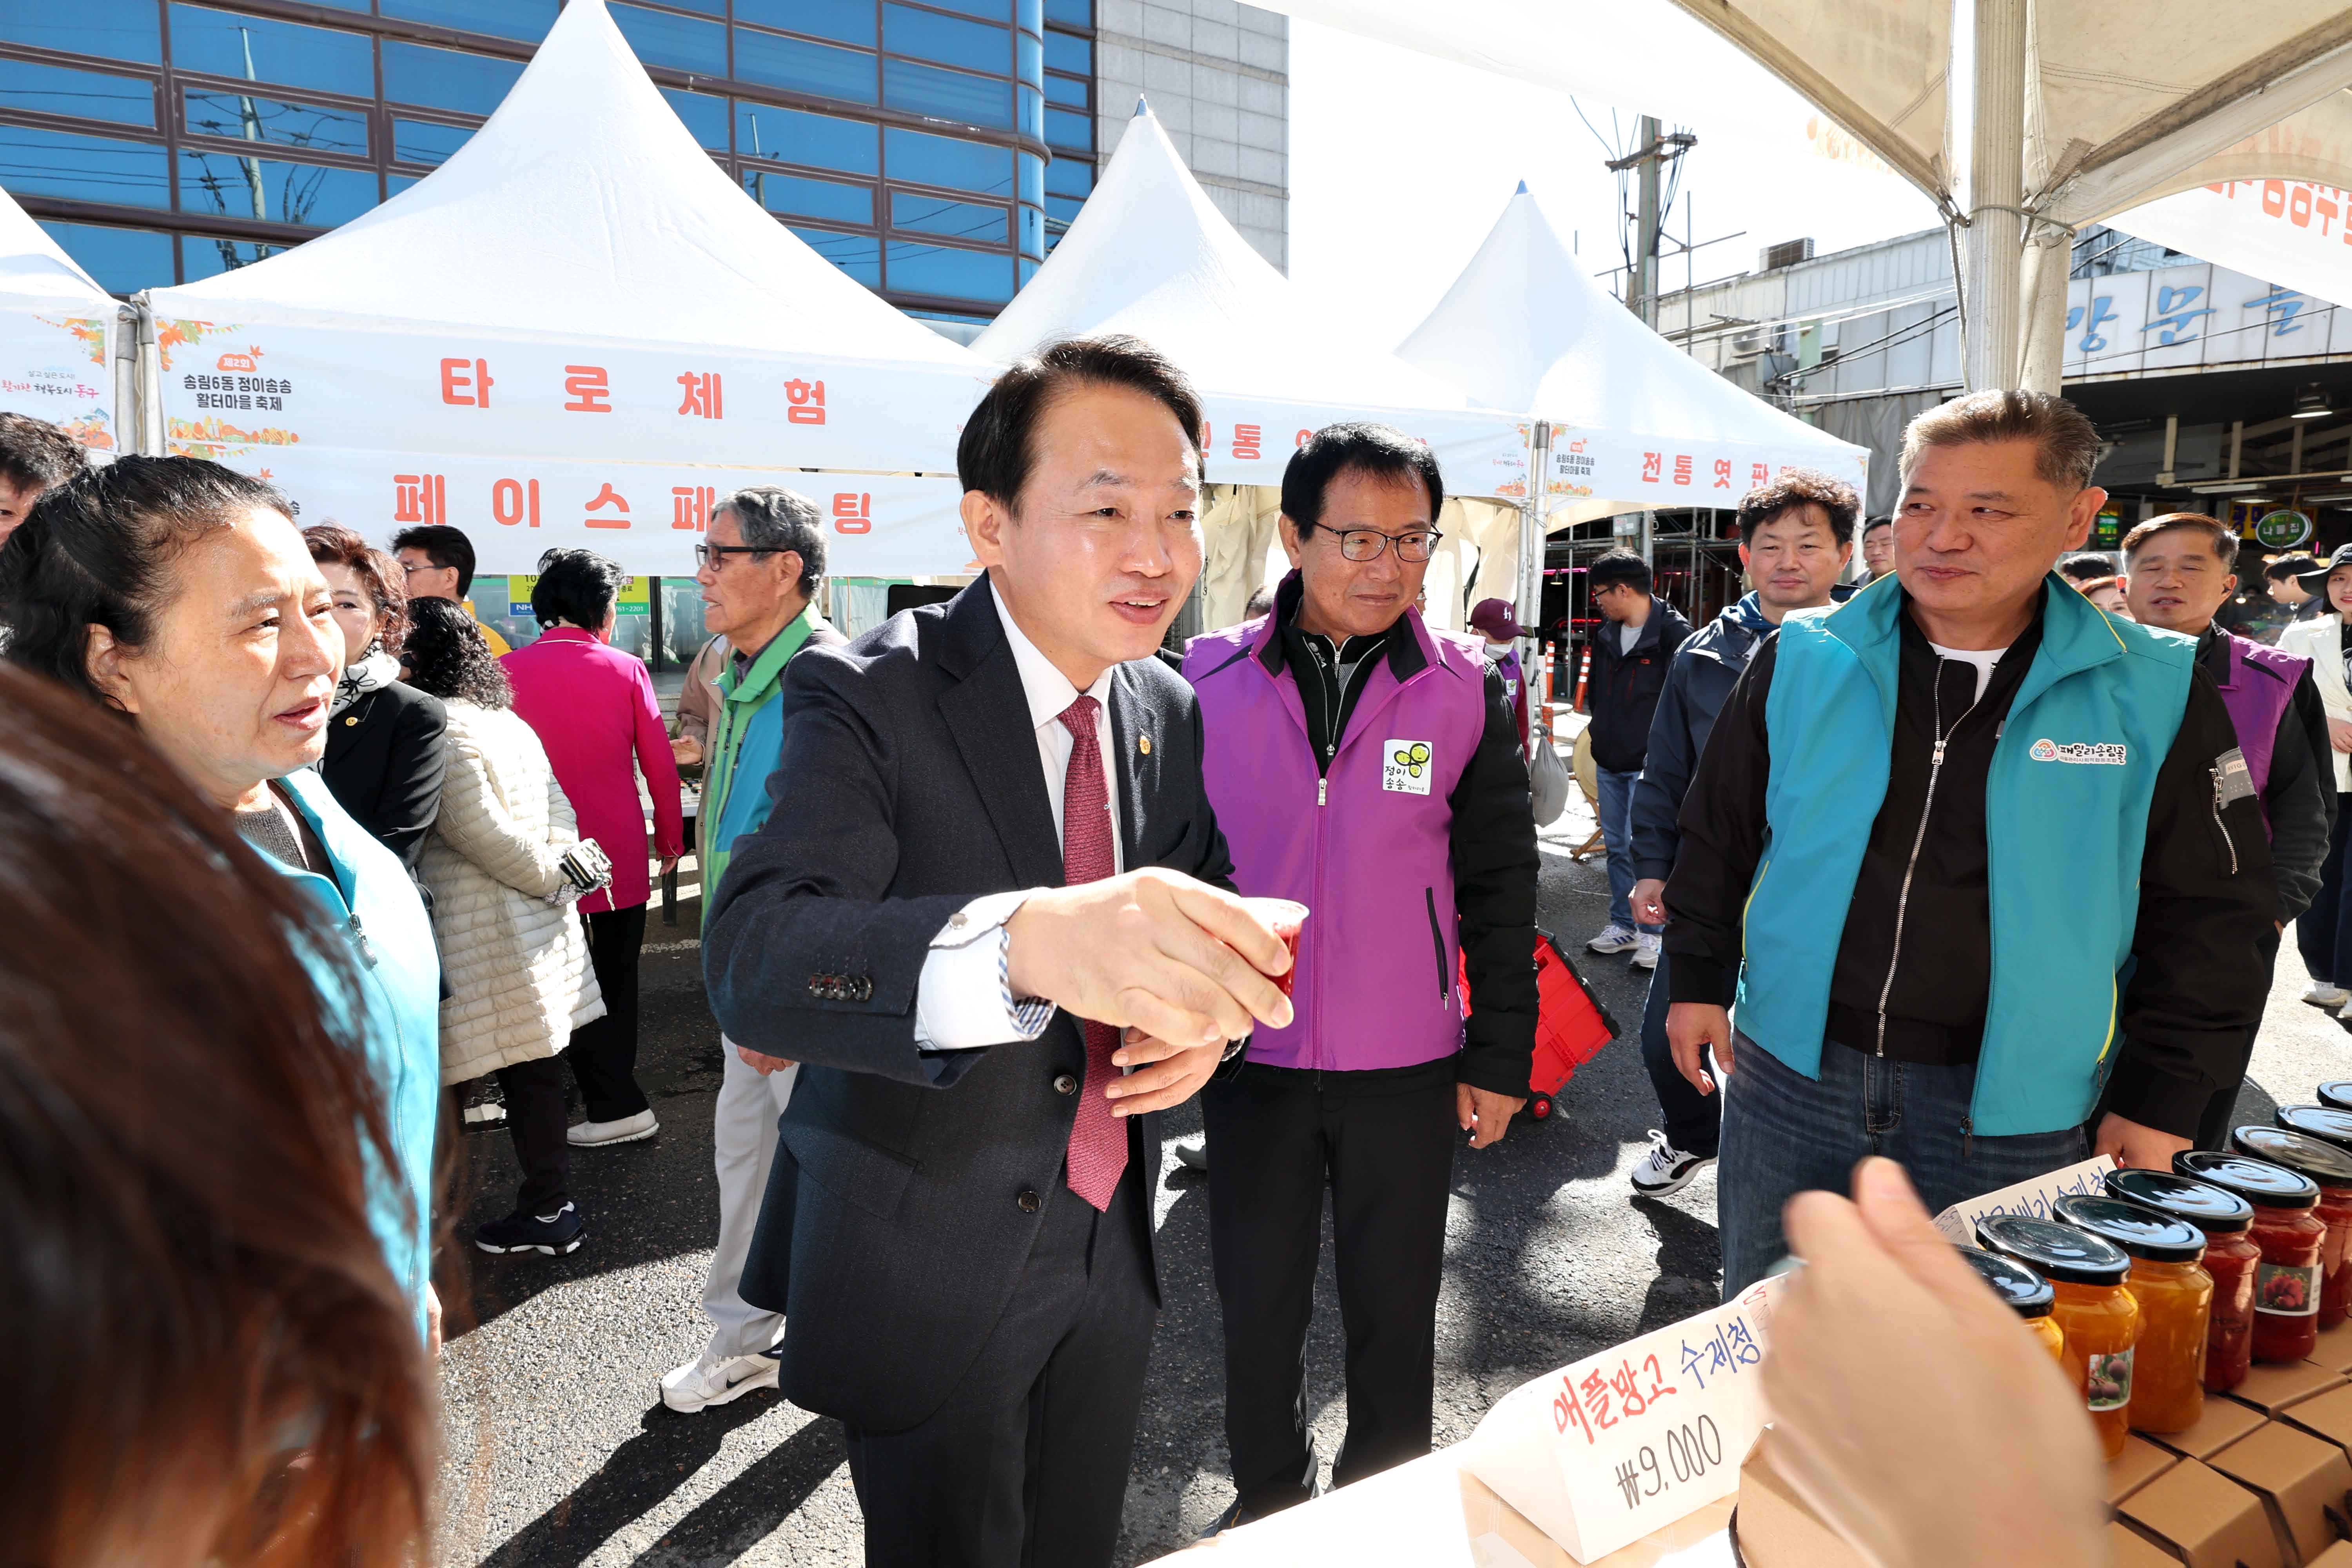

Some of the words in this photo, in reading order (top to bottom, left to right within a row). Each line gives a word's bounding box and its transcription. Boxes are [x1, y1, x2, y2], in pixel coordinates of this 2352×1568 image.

[223, 357, 250, 368] 제2회
[74, 384, 100, 399] 동구
[184, 374, 234, 391] 송림6동
[238, 377, 292, 394] 정이송송
[196, 392, 251, 410] 활터마을
[256, 395, 282, 411] 축제
[393, 473, 872, 535] 페이스페팅
[1385, 766, 1405, 776] 정이
[1386, 778, 1406, 790] 송송
[1554, 1354, 1677, 1445] 애플망고
[1681, 1316, 1761, 1390] 수제청
